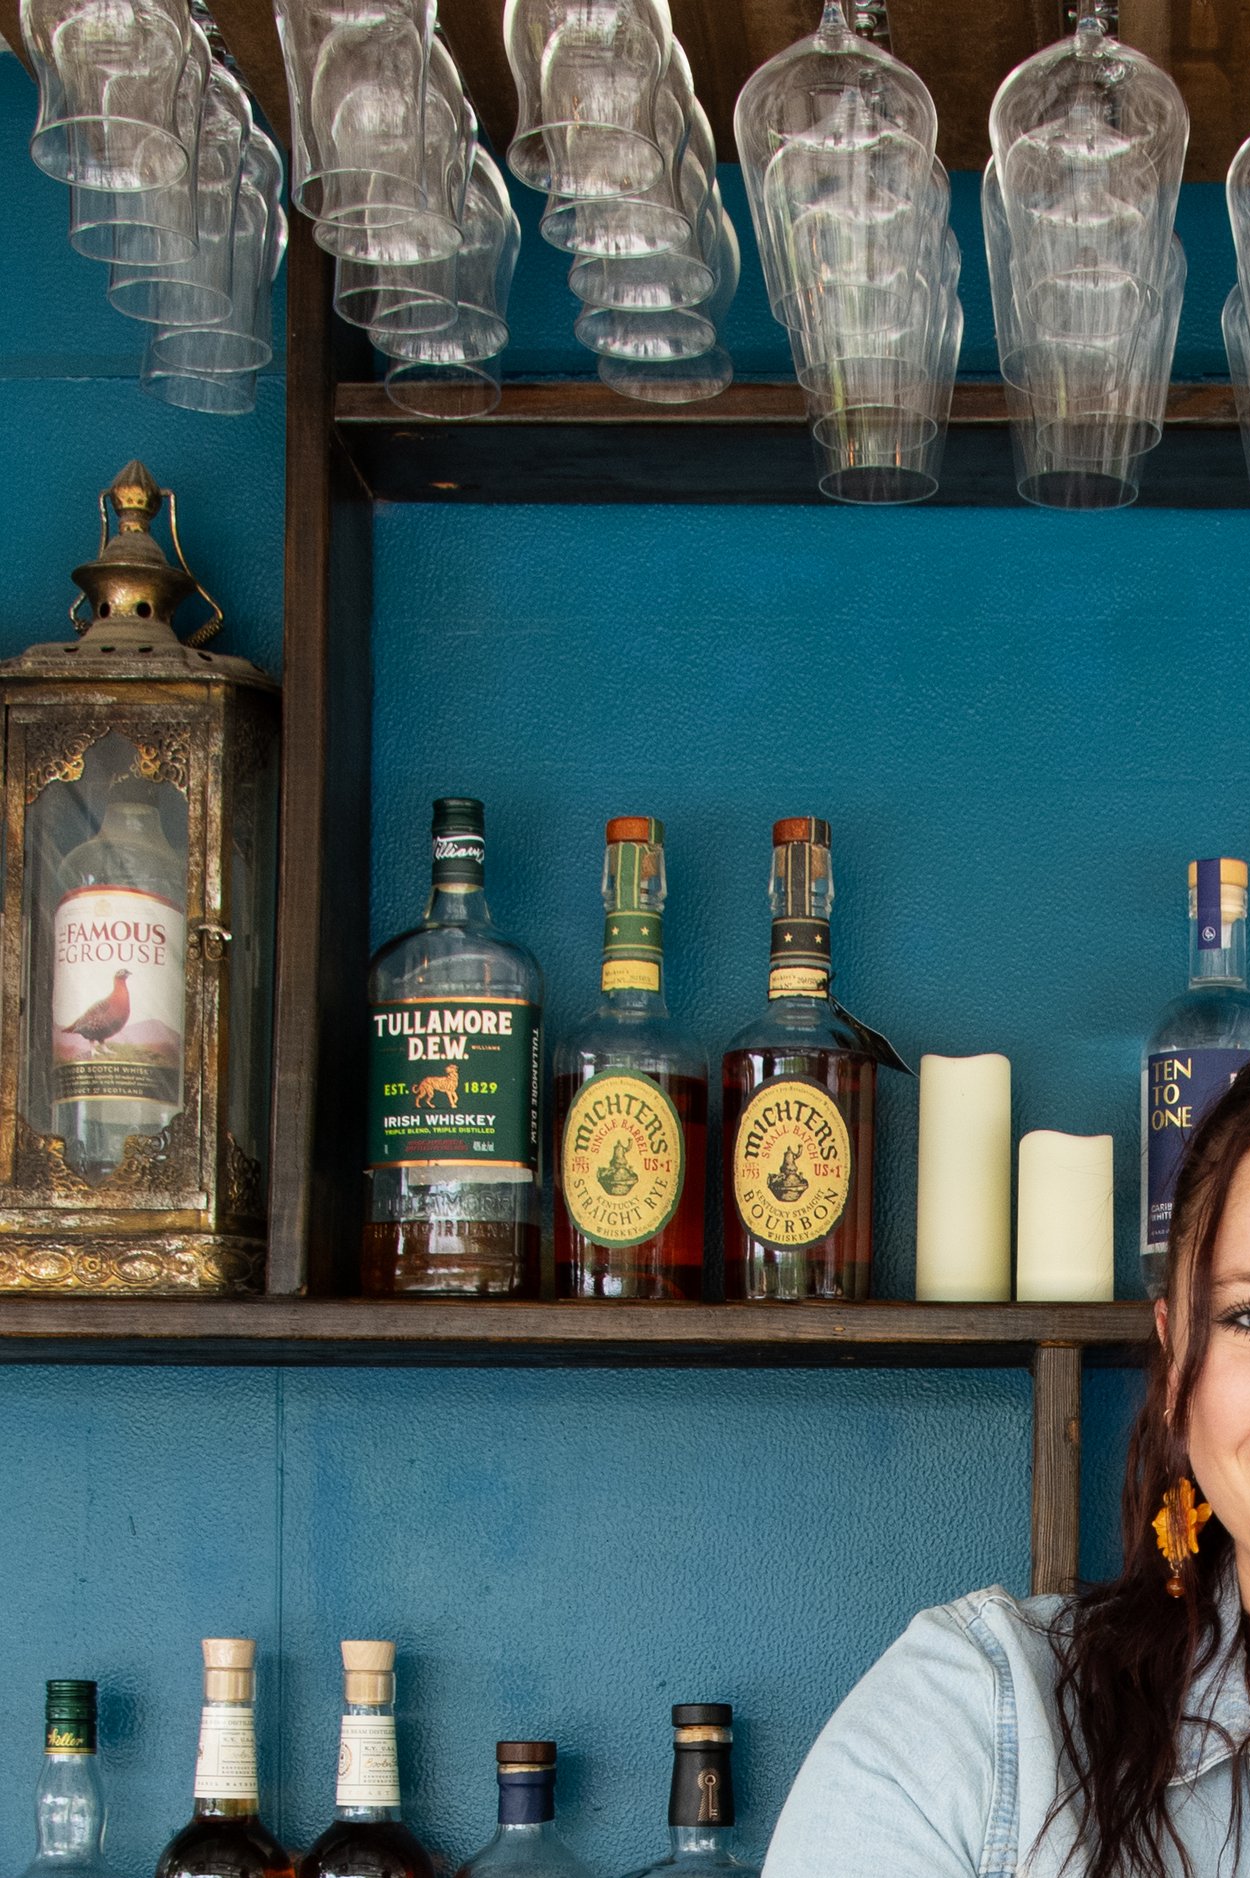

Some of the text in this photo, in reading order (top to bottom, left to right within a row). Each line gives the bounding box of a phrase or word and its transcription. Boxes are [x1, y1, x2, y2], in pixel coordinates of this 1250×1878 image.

[67, 920, 167, 946] FAMOUS
[65, 942, 166, 966] GROUSE
[374, 1010, 513, 1037] TULLAMORE
[408, 1036, 469, 1061] D.E.W.
[87, 1065, 120, 1074] SCOTCH
[530, 1028, 540, 1105] TULLAMORE
[1152, 1057, 1192, 1082] TEN
[103, 1087, 143, 1096] SCOTLAND
[384, 1081, 498, 1096] EST. 1829
[1152, 1084, 1180, 1106] TO
[384, 1113, 496, 1129] IRISH WHISKEY
[384, 1127, 405, 1135] TRIPLE
[1151, 1107, 1193, 1131] ONE
[591, 1118, 648, 1156] SINGLE BARREL
[762, 1124, 819, 1160] SMALL BATCH
[571, 1163, 590, 1173] 1753
[741, 1168, 760, 1179] 1753
[573, 1176, 668, 1226] STRAIGHT RYE
[597, 1196, 640, 1210] KENTUCKY
[743, 1188, 839, 1233] BOURBON
[755, 1189, 825, 1218] KENTUCKY STRAIGHT
[596, 1226, 639, 1236] WHISKEY
[767, 1231, 810, 1243] WHISKEY
